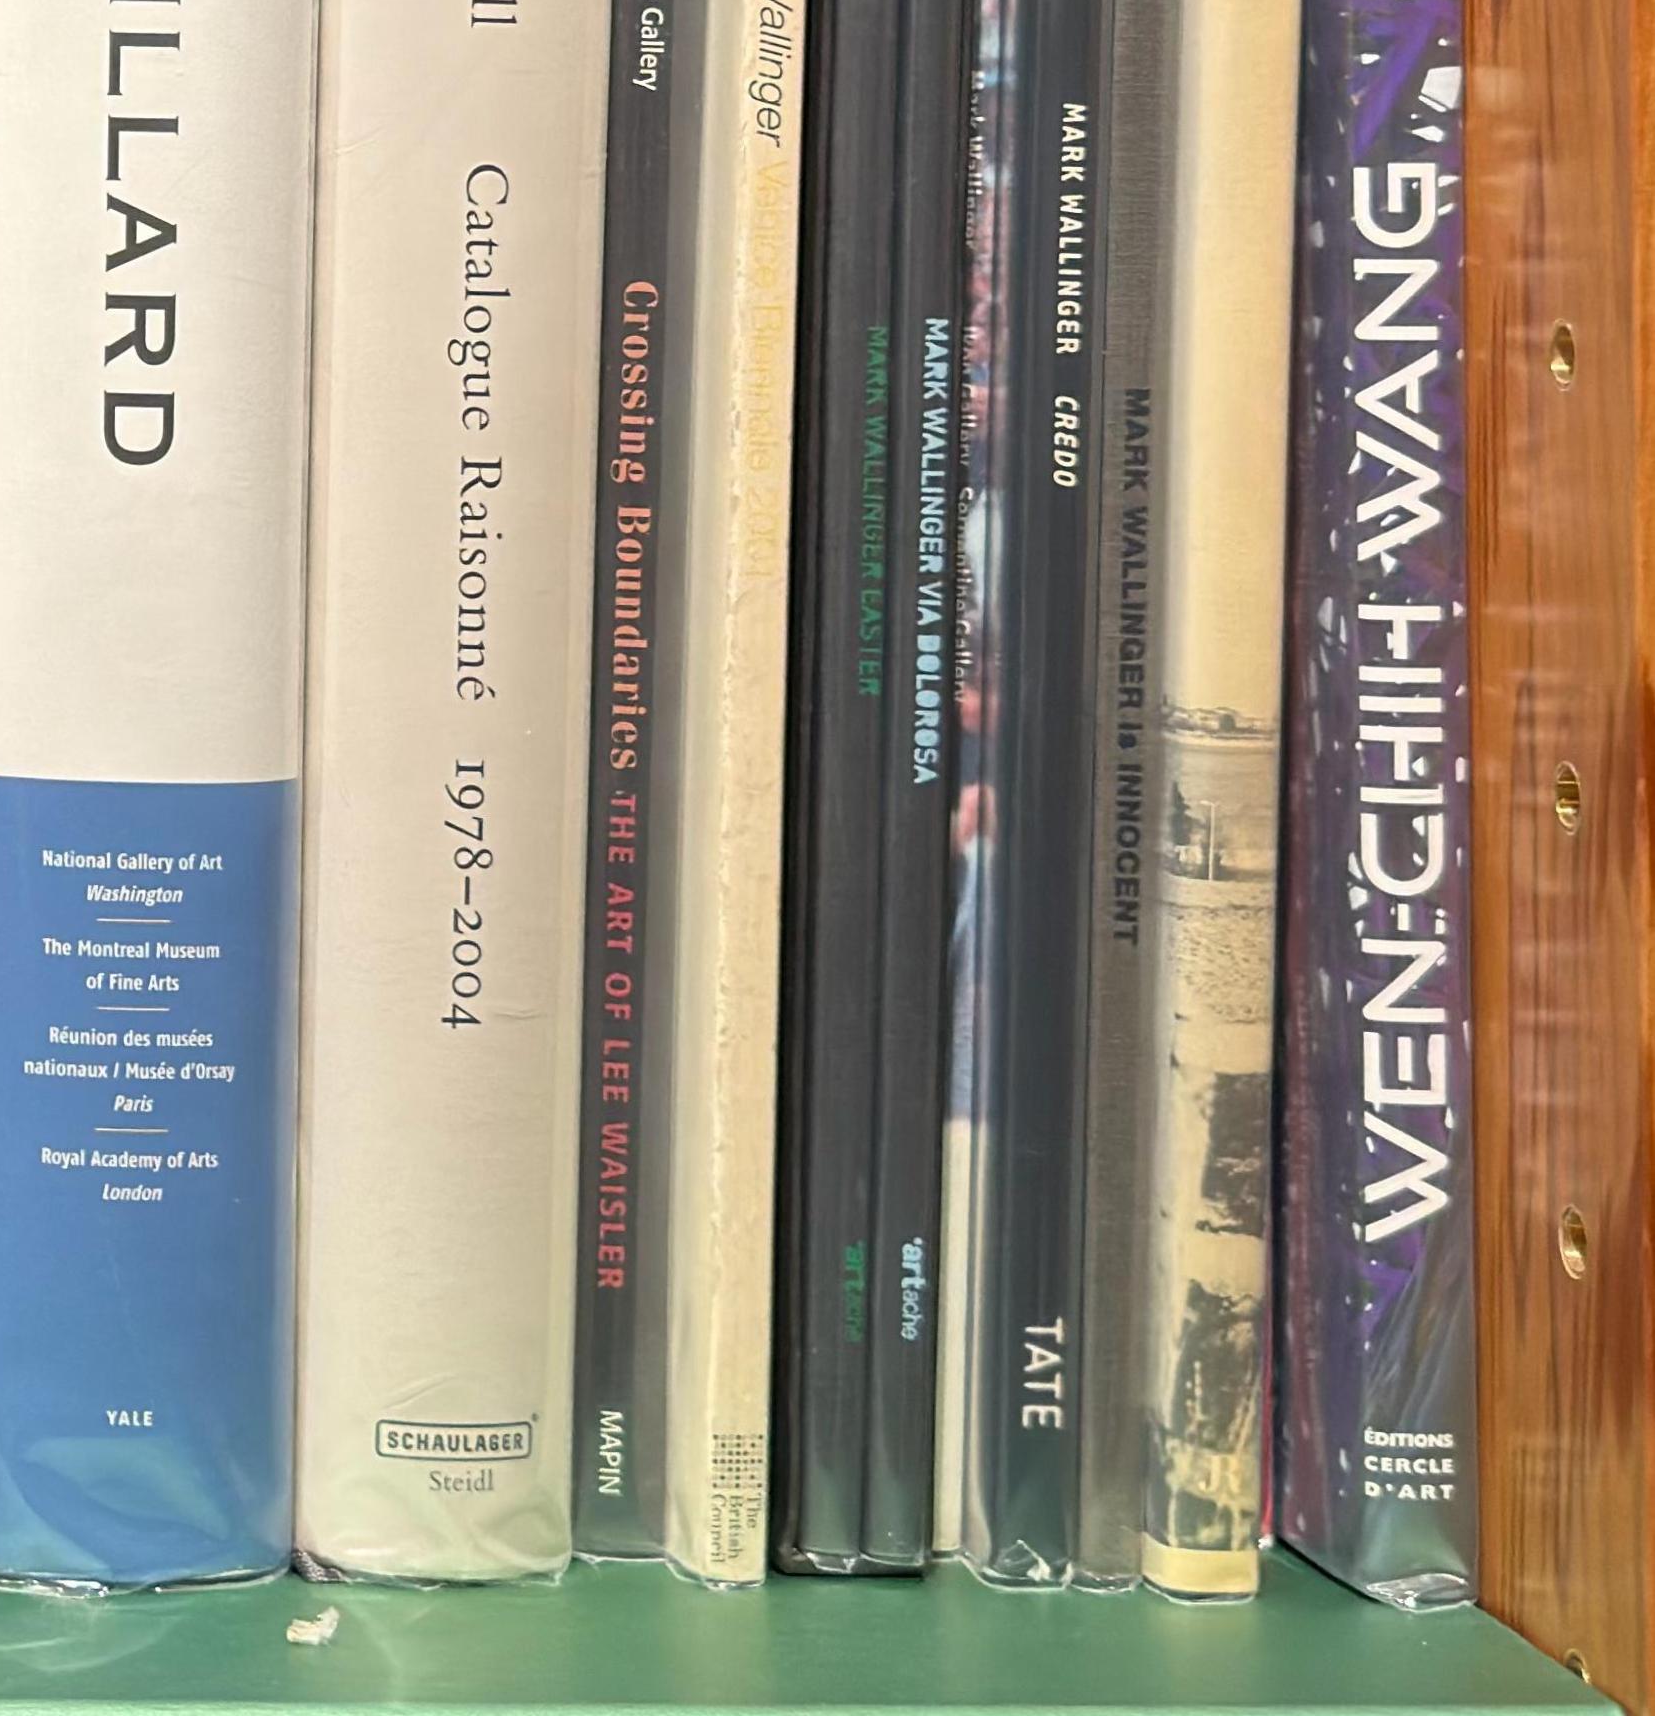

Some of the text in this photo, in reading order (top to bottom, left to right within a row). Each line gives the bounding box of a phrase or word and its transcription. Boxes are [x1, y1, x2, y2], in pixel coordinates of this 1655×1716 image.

[633, 5, 664, 91] Gallery
[446, 162, 515, 431] Catalogue
[1053, 102, 1087, 488] MARK WALLINGER CREDO
[609, 280, 660, 771] Crossing Boundaries
[913, 317, 949, 785] MARK WALLINGER VIA DOLOROSA
[453, 456, 503, 702] Raisonné
[1353, 162, 1454, 1243] WEN-CHIH WANG
[42, 850, 223, 876] National Gallery of Art
[86, 883, 183, 907] Washington
[43, 938, 220, 960] The Montreal Museum
[86, 971, 180, 992] of Fine Arts
[49, 1026, 213, 1049] Réunion des musées
[23, 1057, 107, 1079] nationaux
[125, 1059, 175, 1081] Musée
[113, 1093, 153, 1114] Paris
[41, 1147, 219, 1173] Royal Academy of Arts
[102, 1182, 163, 1203] London
[1022, 1316, 1065, 1431] TATE
[106, 1410, 153, 1427] YALE
[385, 1430, 526, 1454] SCHAULAGER
[597, 1409, 625, 1495] MAPIN
[428, 1467, 494, 1492] Steidl
